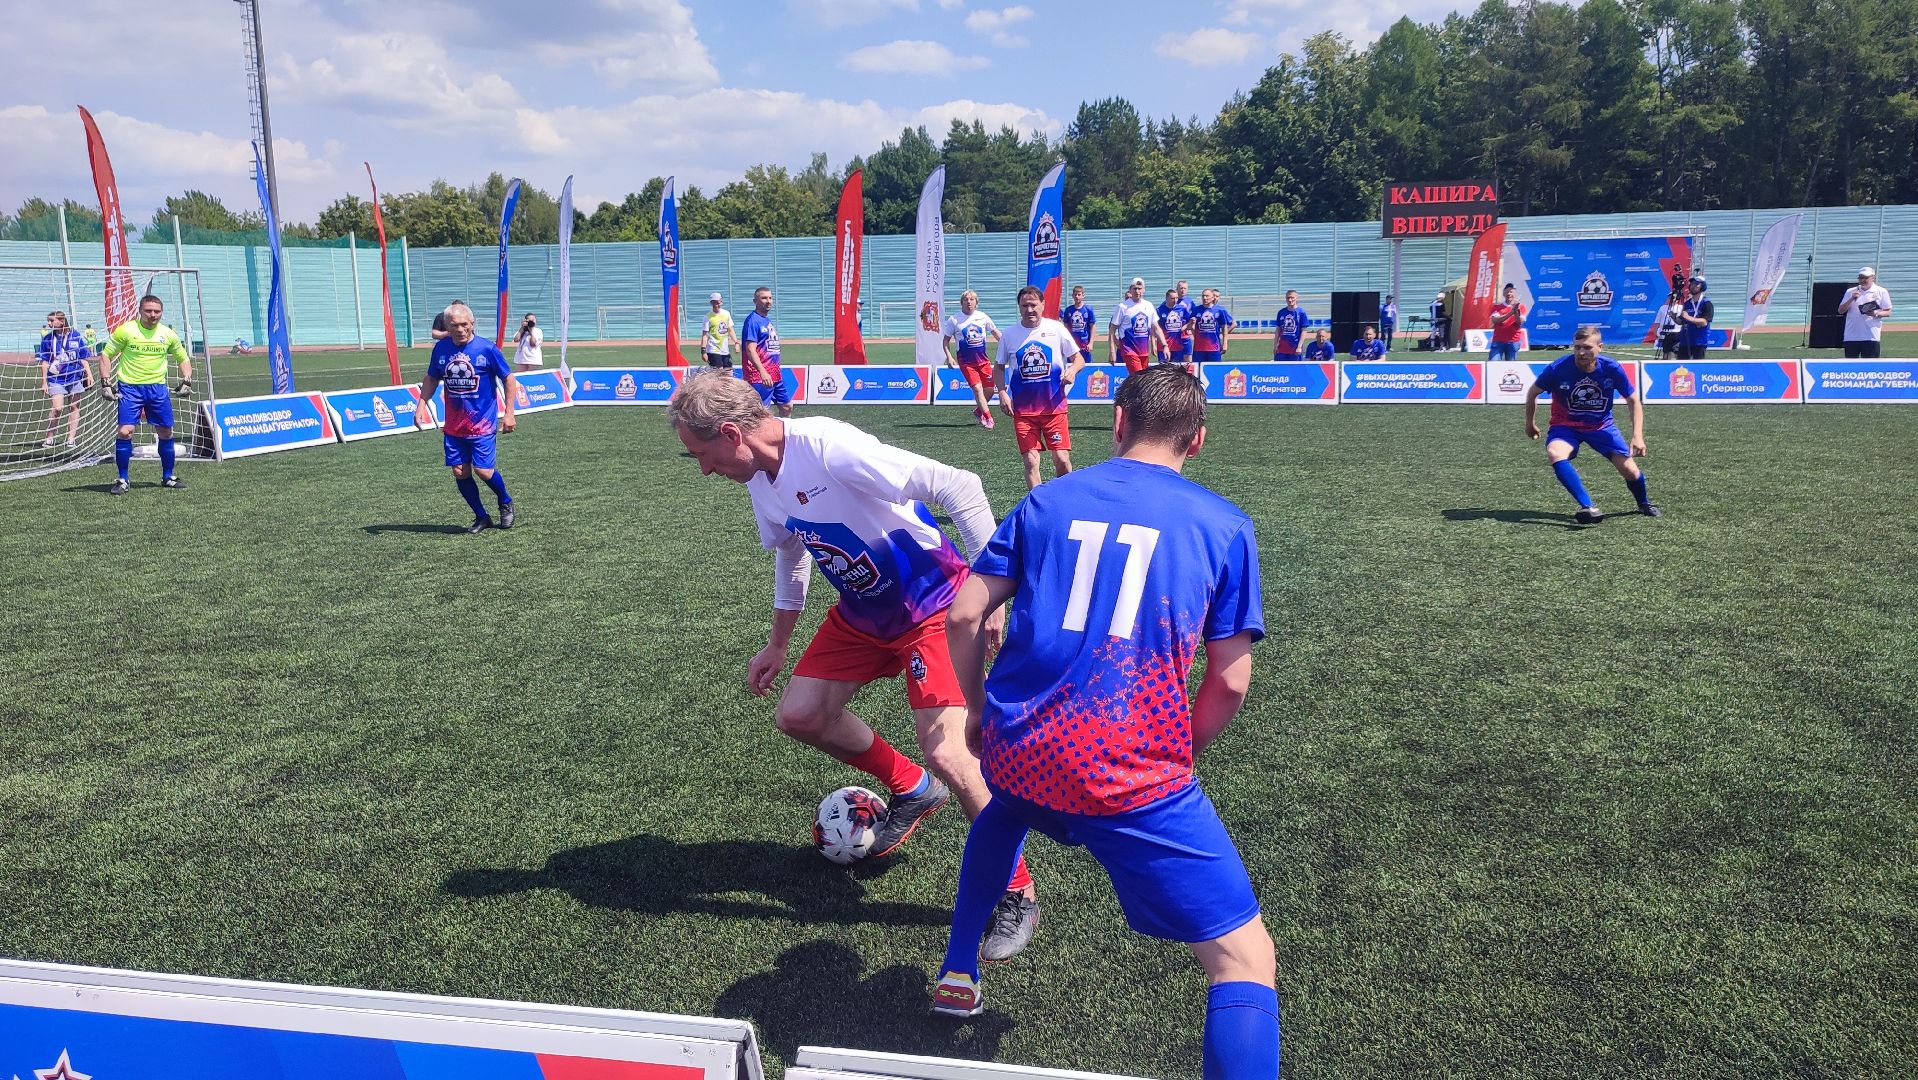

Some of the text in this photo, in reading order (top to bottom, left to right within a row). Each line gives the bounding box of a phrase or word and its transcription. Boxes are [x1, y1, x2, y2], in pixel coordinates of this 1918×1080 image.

[1390, 184, 1496, 205] КАШИРА
[1391, 213, 1493, 235] ВПЕРЕД!
[1251, 375, 1290, 384] Команда
[1356, 373, 1438, 381] #ВЫХОДИВОДВОР
[1701, 373, 1745, 383] Команда
[1821, 371, 1912, 381] #ВЫХОДИВОДВОР
[1251, 385, 1307, 395] Губернатора
[1356, 381, 1469, 390] #КОМАНДАГУБЕРНАТОРА
[1701, 384, 1765, 394] Губернатора
[223, 409, 292, 427] #ВЫХОДИВОДВОР
[228, 417, 320, 438] #КОМАНДАГУБЕРНАТОРА
[1062, 519, 1161, 640] 11
